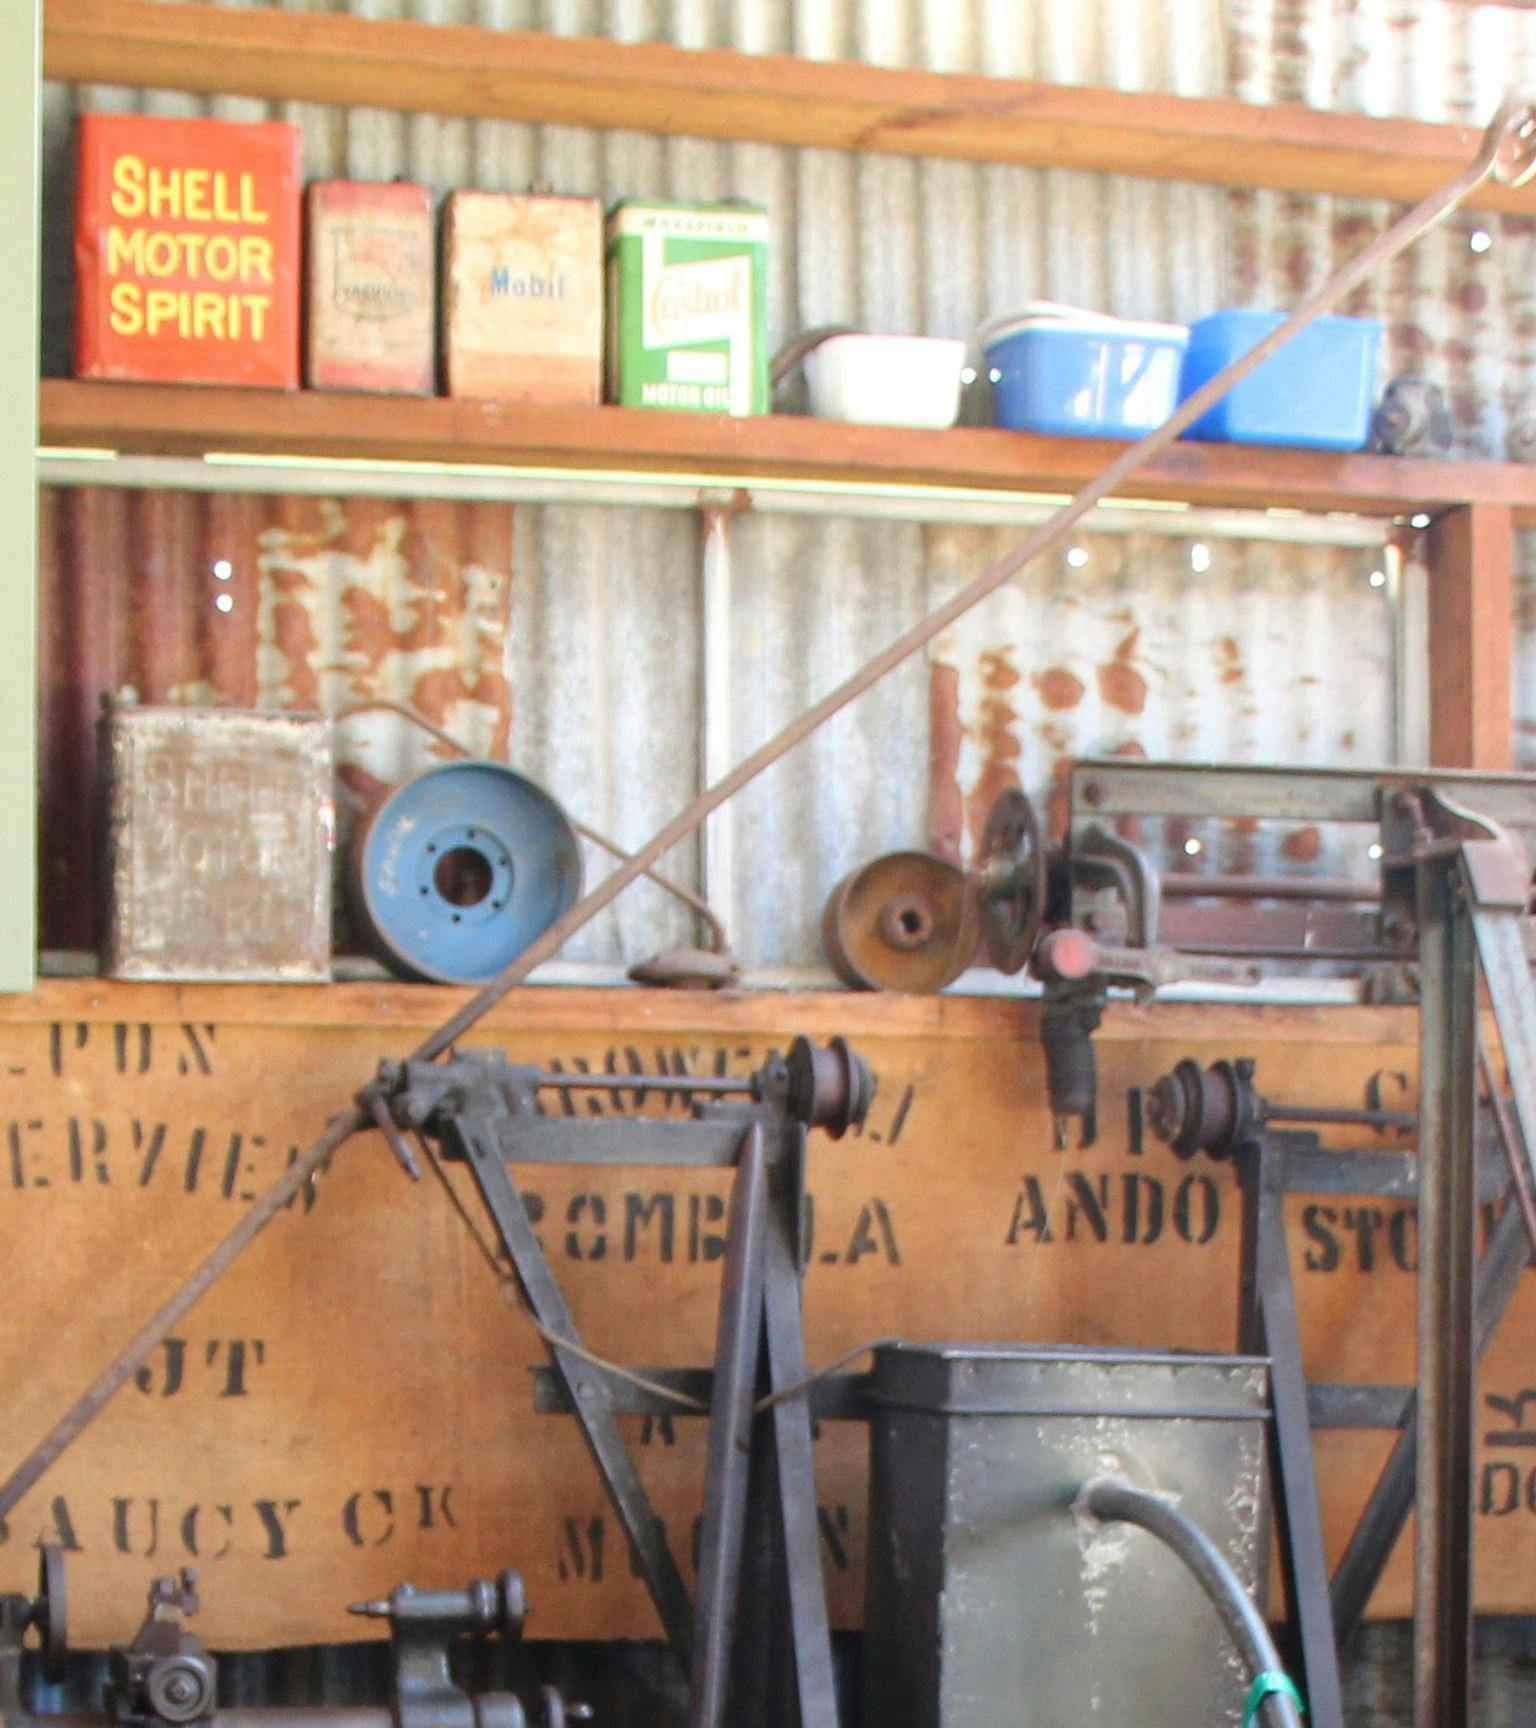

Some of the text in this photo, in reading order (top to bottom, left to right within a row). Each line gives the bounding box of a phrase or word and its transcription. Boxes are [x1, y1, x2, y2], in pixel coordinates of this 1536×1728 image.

[111, 154, 269, 224] SHELL
[107, 224, 275, 283] MOTOR
[491, 264, 566, 298] Mobil
[109, 281, 271, 342] SPIRIT
[641, 381, 702, 408] MOTOR
